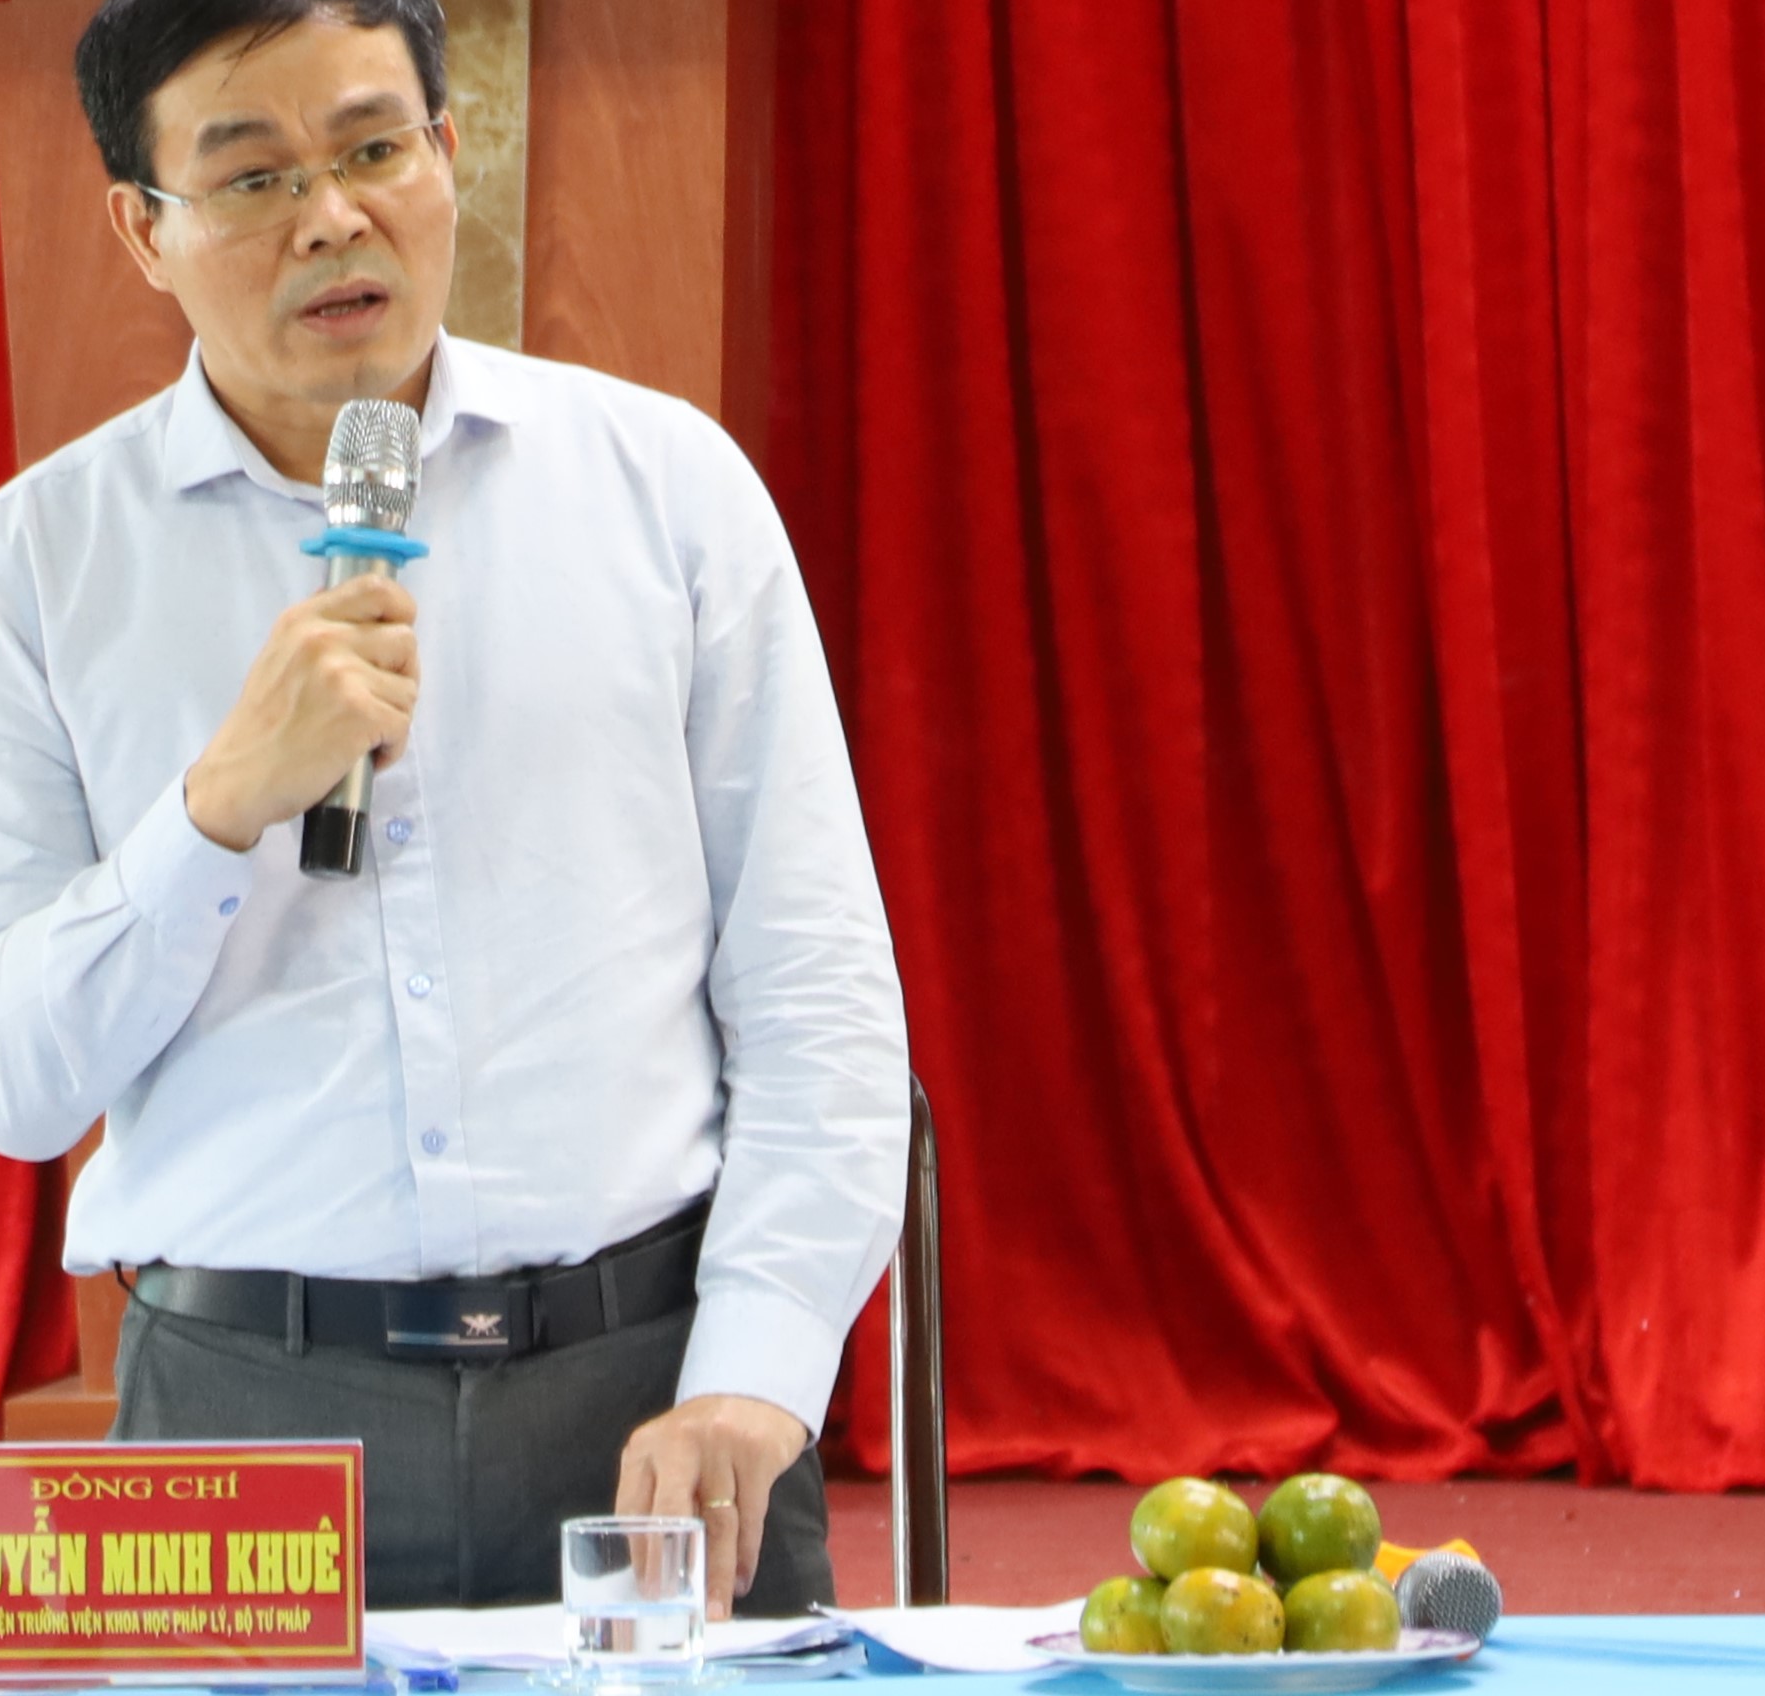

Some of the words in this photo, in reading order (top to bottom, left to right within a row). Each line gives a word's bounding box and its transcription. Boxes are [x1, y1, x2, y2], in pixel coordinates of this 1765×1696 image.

[165, 1470, 239, 1500] CHÍ
[102, 1531, 212, 1595] MINH
[226, 1515, 341, 1595] KHUÊ
[72, 1606, 102, 1639] VIỆN
[105, 1610, 140, 1635] KHOA
[143, 1609, 170, 1638] HỌC
[173, 1605, 207, 1634] PHÁP
[277, 1604, 312, 1634] PHÁP
